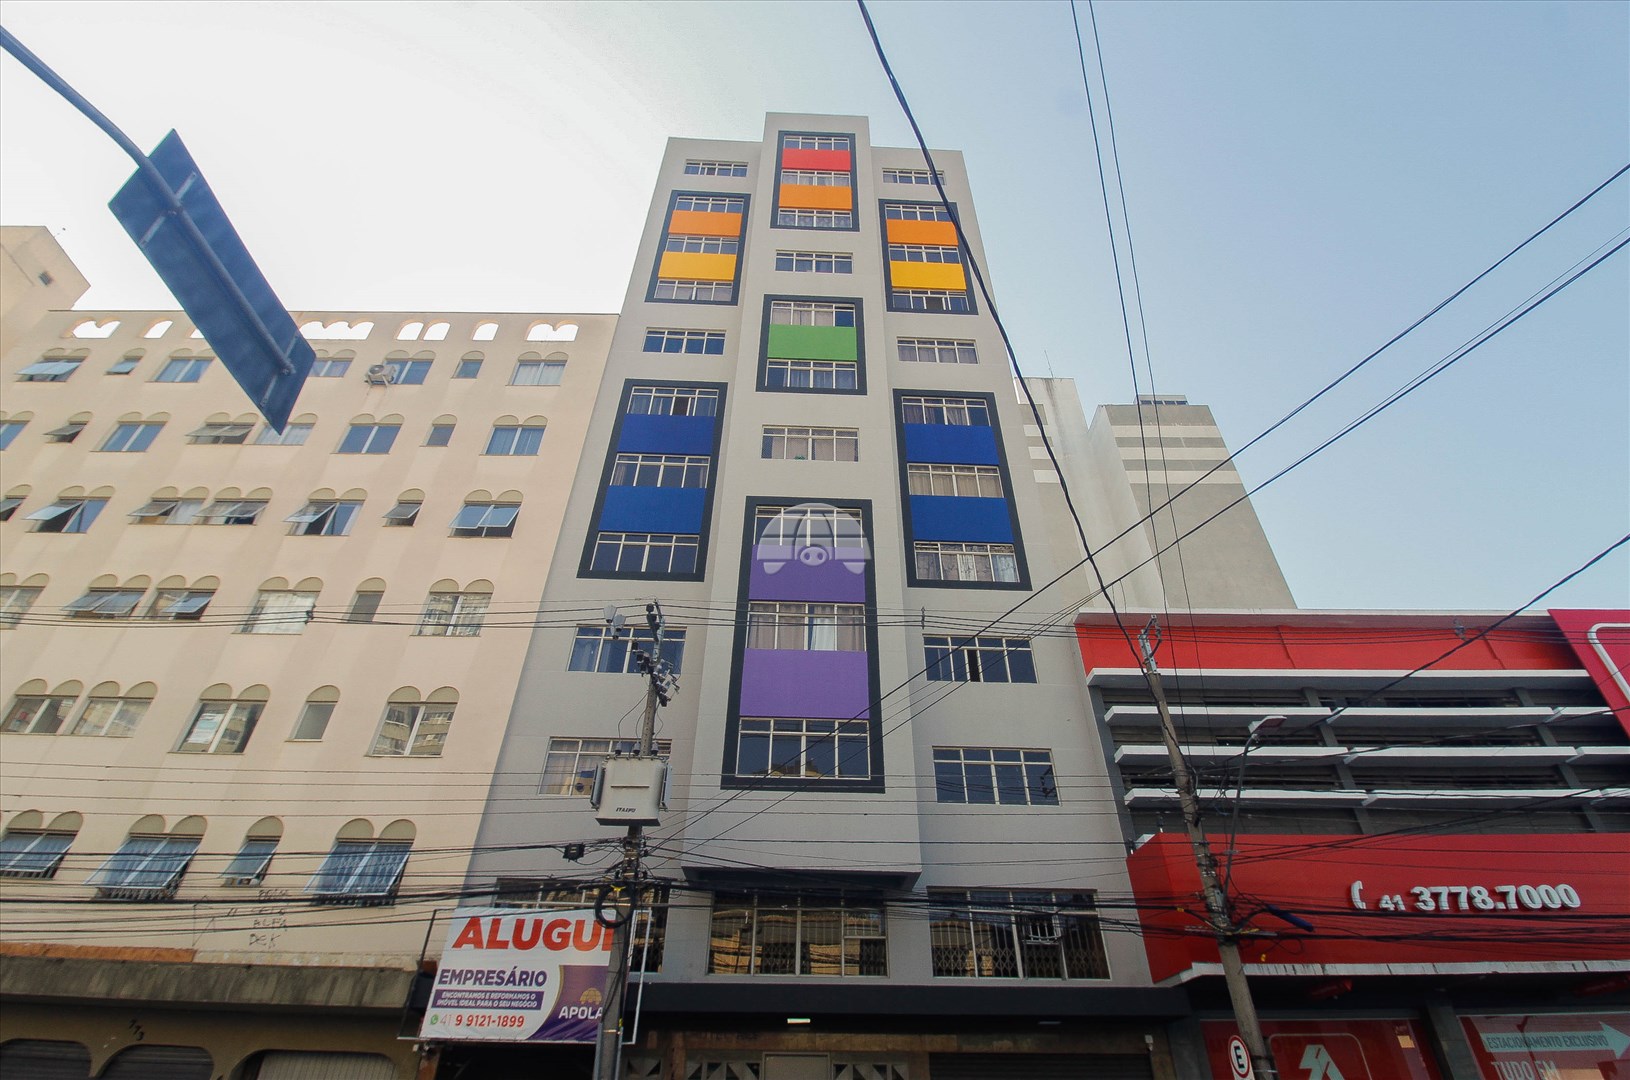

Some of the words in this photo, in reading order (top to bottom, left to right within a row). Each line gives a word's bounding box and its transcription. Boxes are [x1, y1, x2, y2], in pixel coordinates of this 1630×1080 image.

[1379, 894, 1406, 911] 41
[1410, 884, 1581, 912] 3778.7000
[438, 966, 547, 987] EMPRESÁRIO
[436, 998, 459, 1007] IMÓVEL
[476, 1000, 492, 1008] PARA
[511, 1000, 538, 1009] NEGÓCIO
[441, 991, 485, 1000] ENCONTRAMOS
[490, 992, 530, 1001] REFORMAMOS
[455, 1014, 463, 1027] 9
[466, 1014, 525, 1028] 9121-1899
[1486, 1035, 1562, 1049] ESTACIONAMENTO
[1562, 1034, 1610, 1047] EXCLUSIVO
[1233, 1045, 1246, 1069] E
[1491, 1060, 1536, 1080] TUDO
